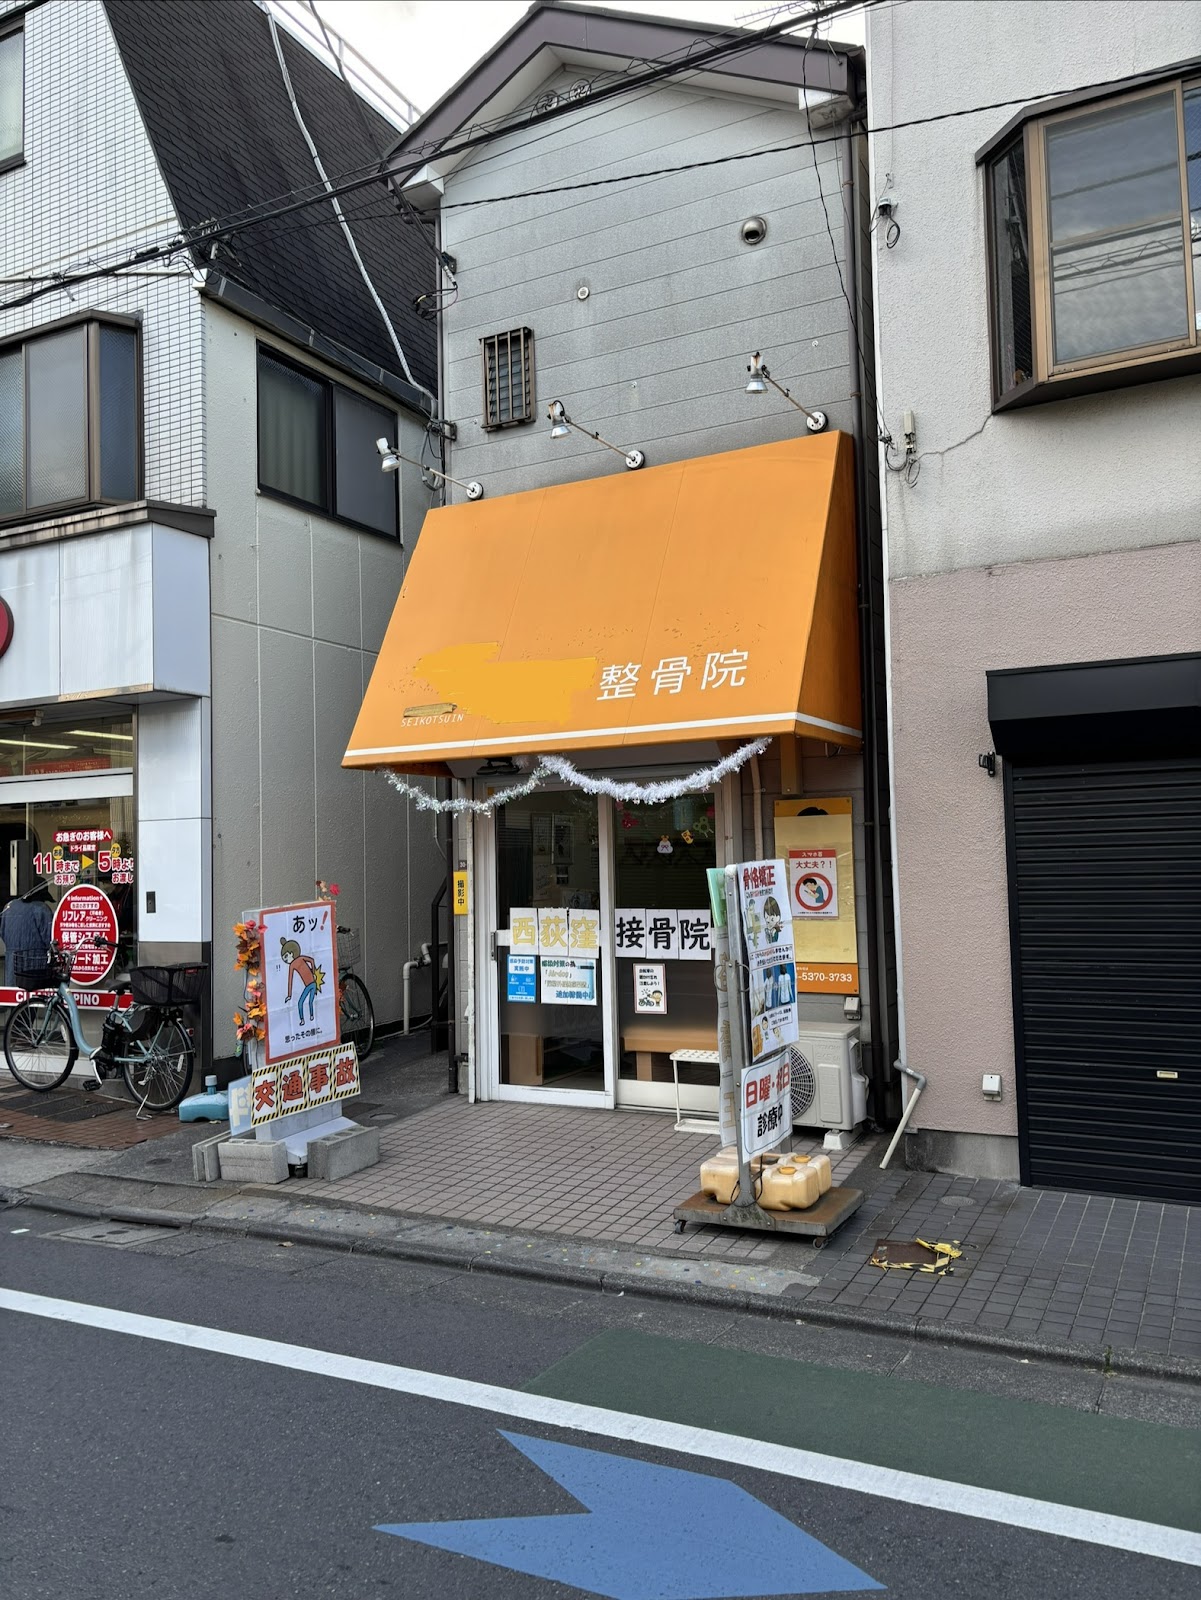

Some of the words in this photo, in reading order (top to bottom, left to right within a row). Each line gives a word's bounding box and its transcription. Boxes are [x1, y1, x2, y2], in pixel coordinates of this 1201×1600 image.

[596, 649, 748, 701] 整骨院
[401, 714, 464, 727] SEIKOTSUIN
[55, 830, 111, 843] お急ぎのお客様へ
[743, 865, 776, 890] 骨格矯正
[457, 879, 465, 906] 撮影中
[62, 910, 86, 922] リフレア
[512, 915, 599, 949] 西荻窪
[615, 915, 711, 951] 接骨院
[73, 993, 100, 1005] PINO
[255, 1056, 356, 1112] 交通事故
[757, 1103, 783, 1138] 診療中
